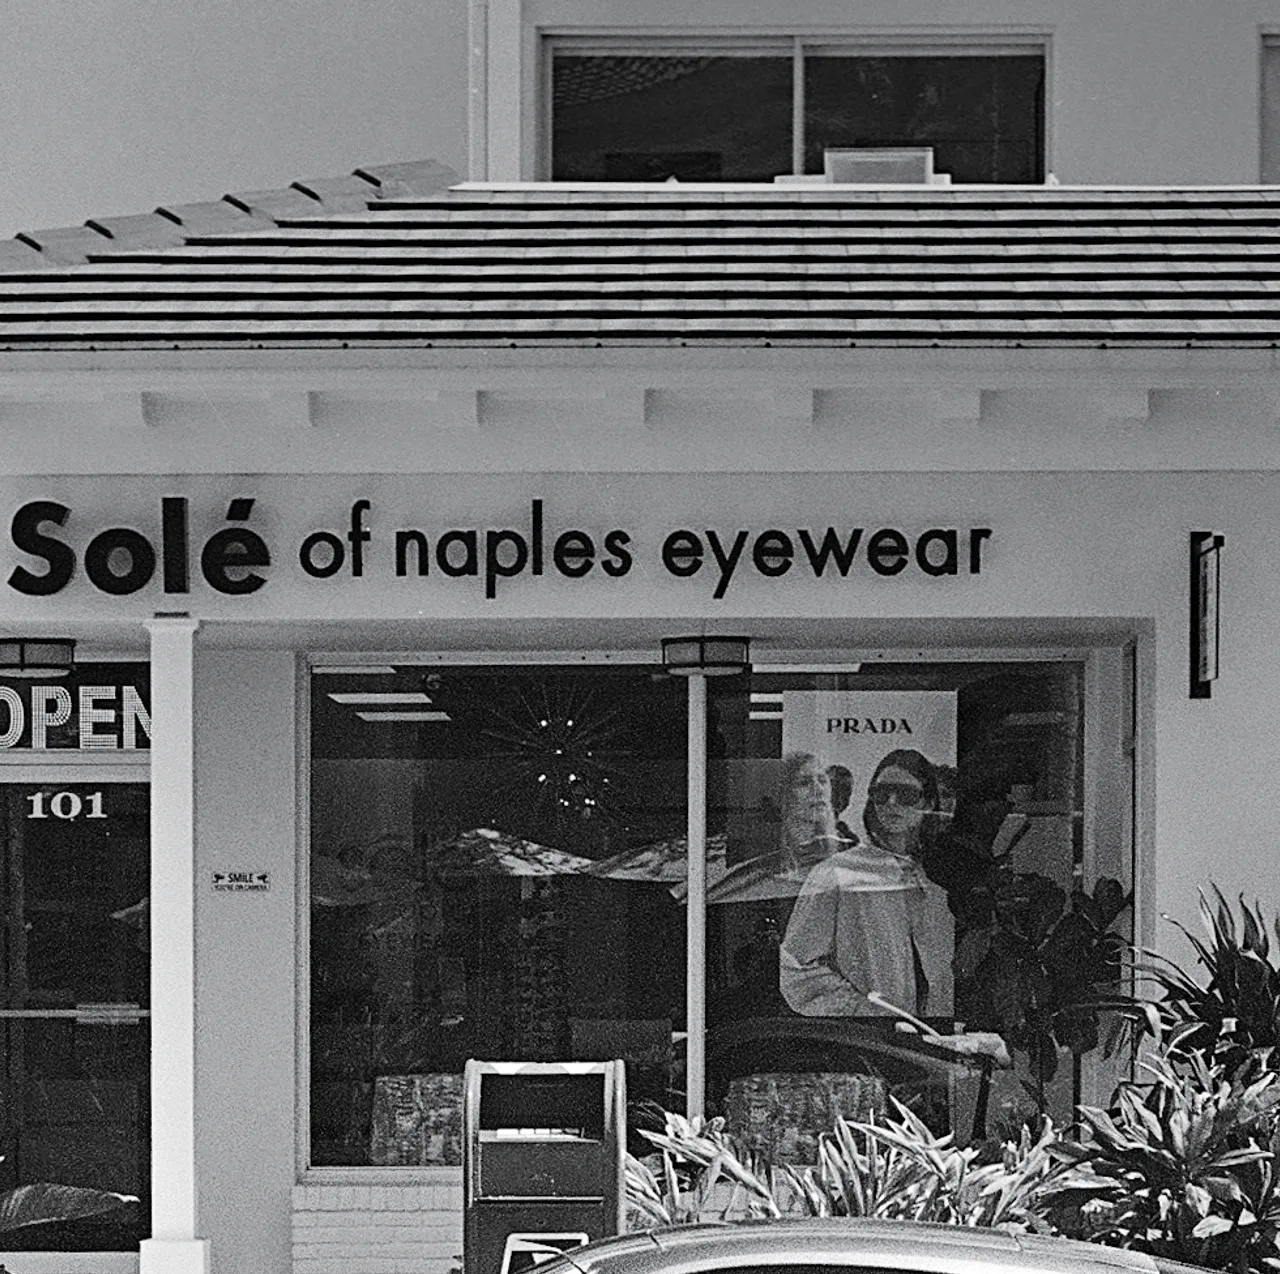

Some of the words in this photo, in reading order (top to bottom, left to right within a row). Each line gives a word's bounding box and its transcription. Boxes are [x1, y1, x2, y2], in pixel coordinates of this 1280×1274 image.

[7, 497, 272, 597] Solé
[299, 499, 372, 579] of
[395, 499, 633, 600] naples
[661, 526, 994, 600] eyewear
[826, 717, 913, 735] PRADA
[26, 791, 108, 819] 101
[228, 872, 254, 883] SMILE
